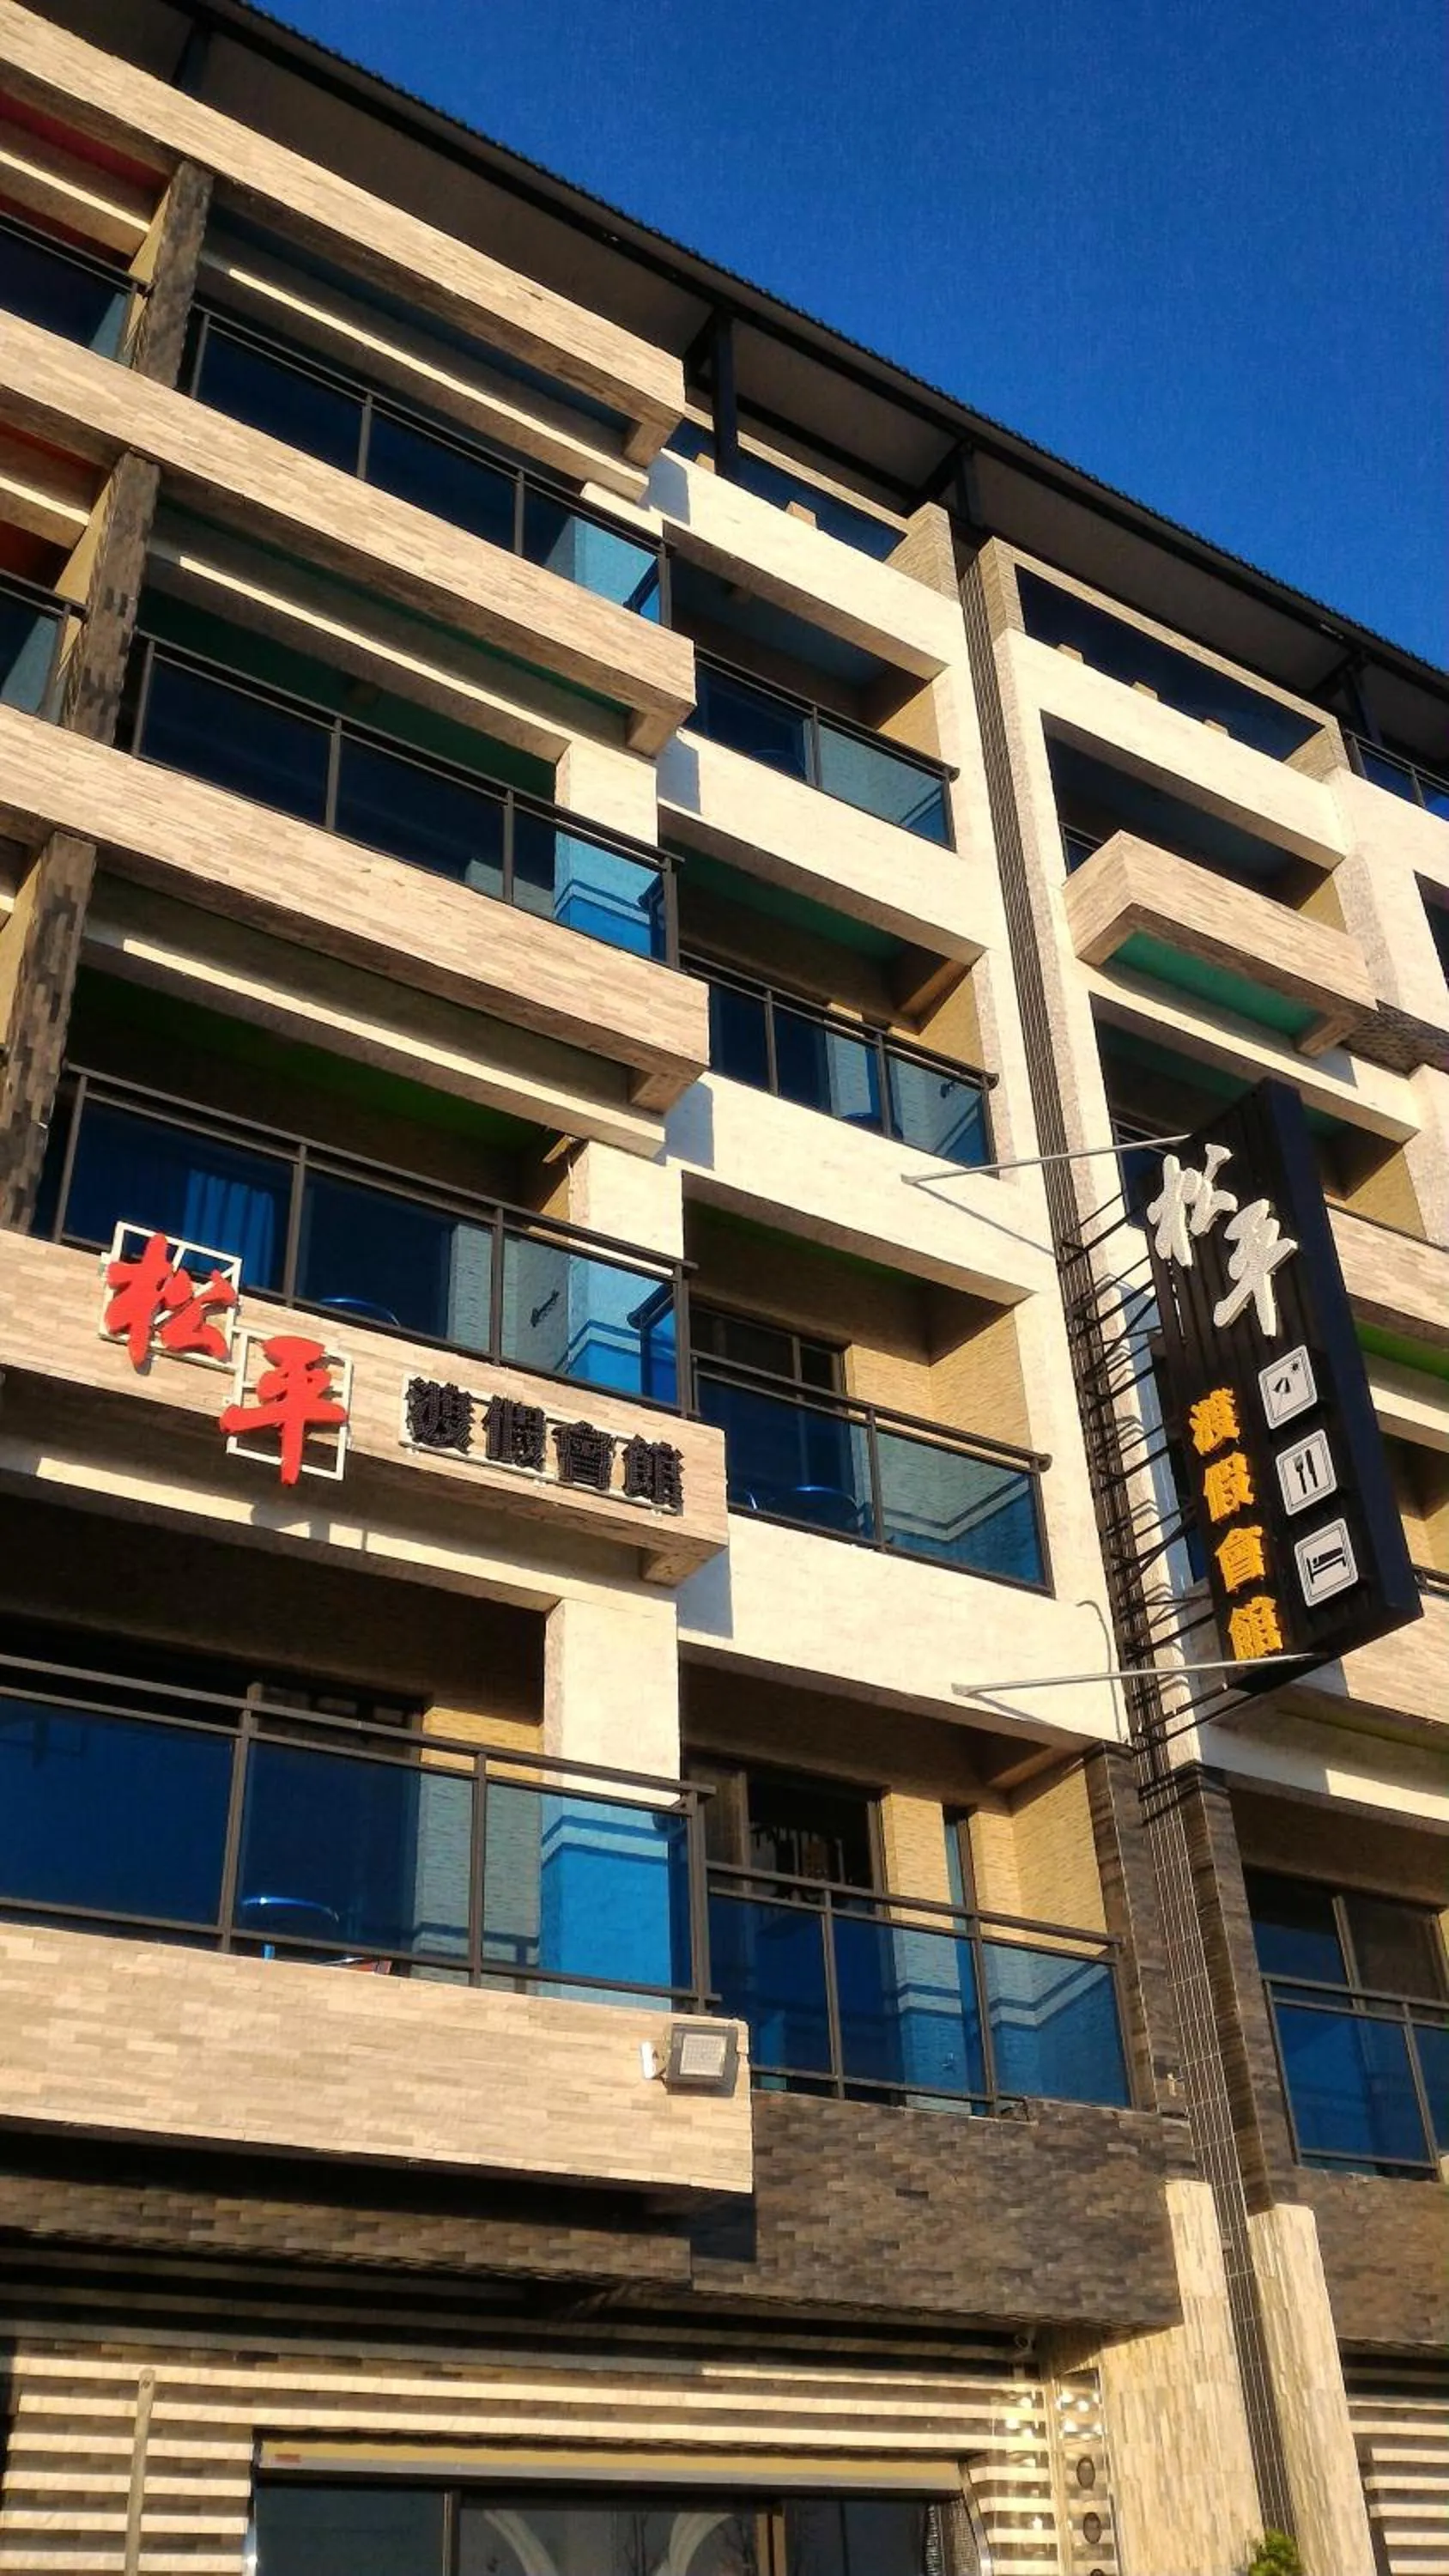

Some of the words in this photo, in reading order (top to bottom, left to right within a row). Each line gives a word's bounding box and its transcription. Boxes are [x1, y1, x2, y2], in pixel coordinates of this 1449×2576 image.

[405, 1376, 684, 1513] 渡假會館
[1189, 1388, 1283, 1662] 渡假會館
